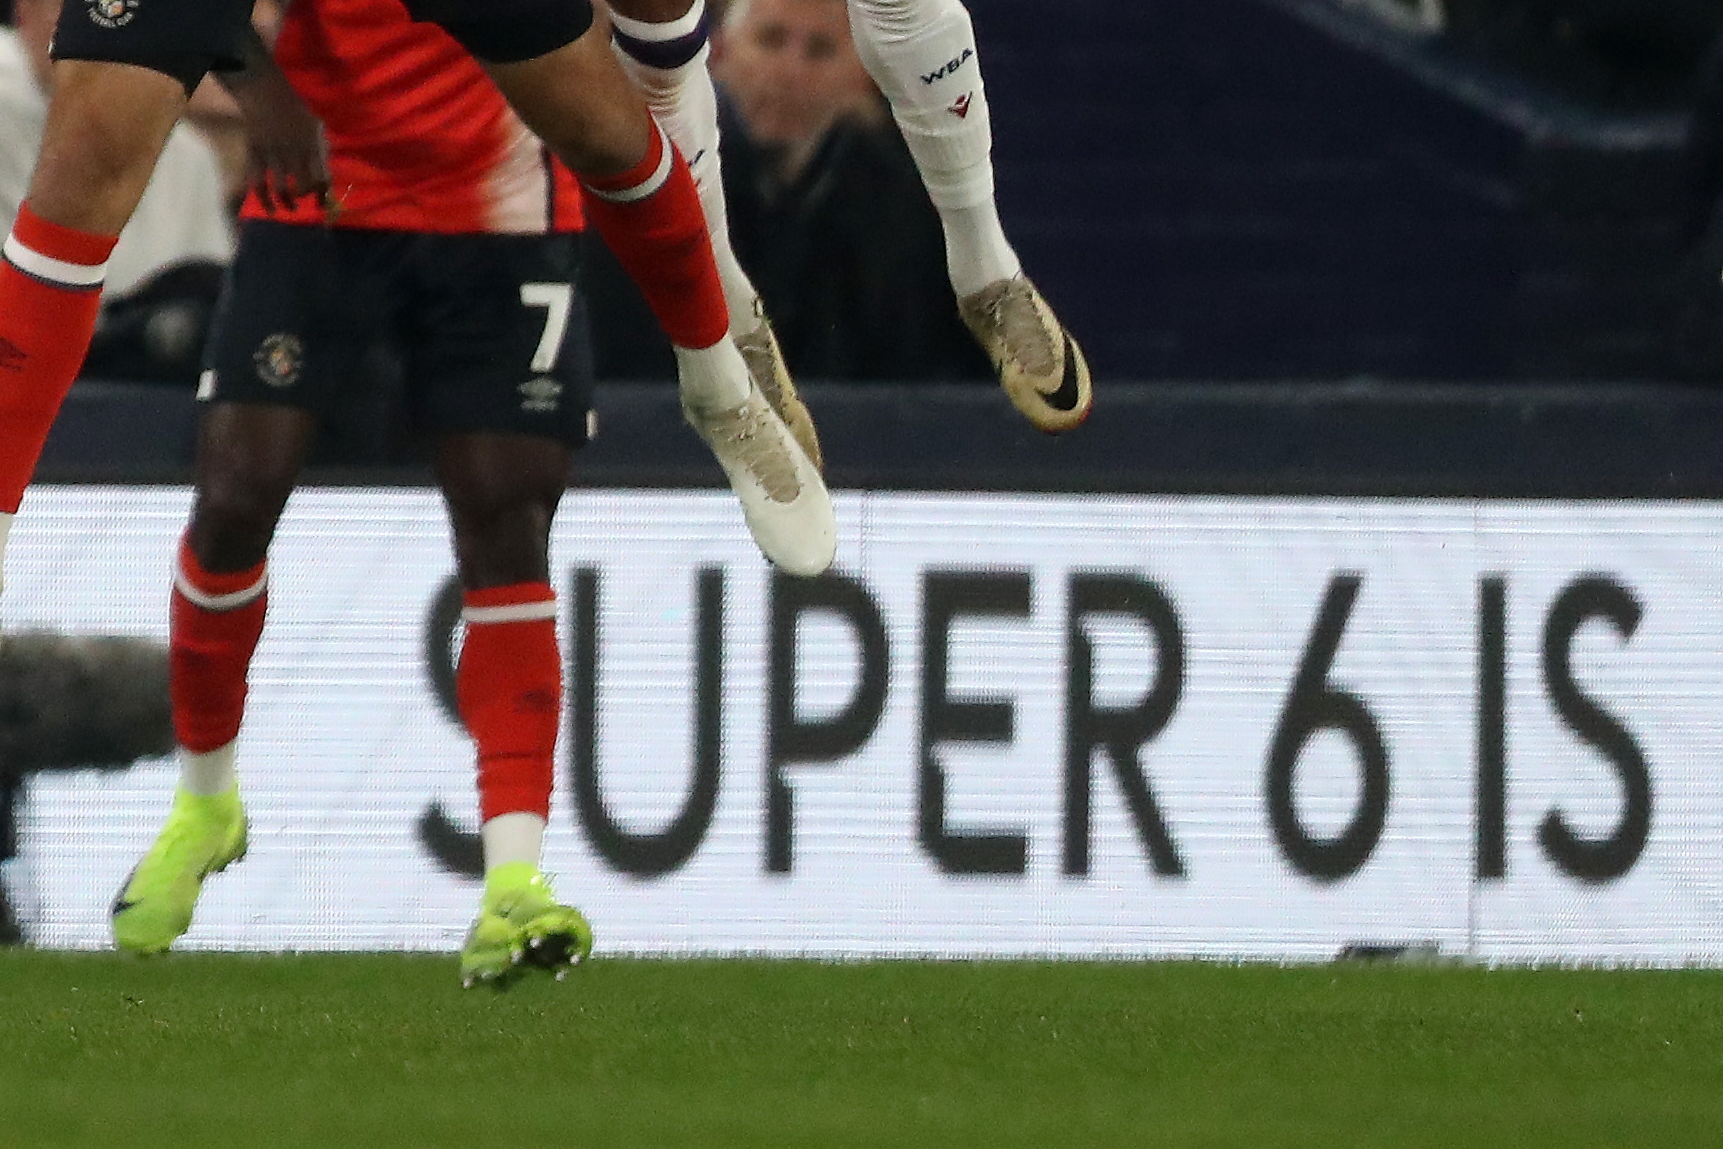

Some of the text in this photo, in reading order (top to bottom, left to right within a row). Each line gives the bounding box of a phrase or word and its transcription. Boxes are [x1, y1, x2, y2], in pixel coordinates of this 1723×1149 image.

[920, 47, 973, 84] WBA
[520, 282, 573, 373] 7
[1264, 575, 1391, 885] 6
[1472, 572, 1655, 886] IS
